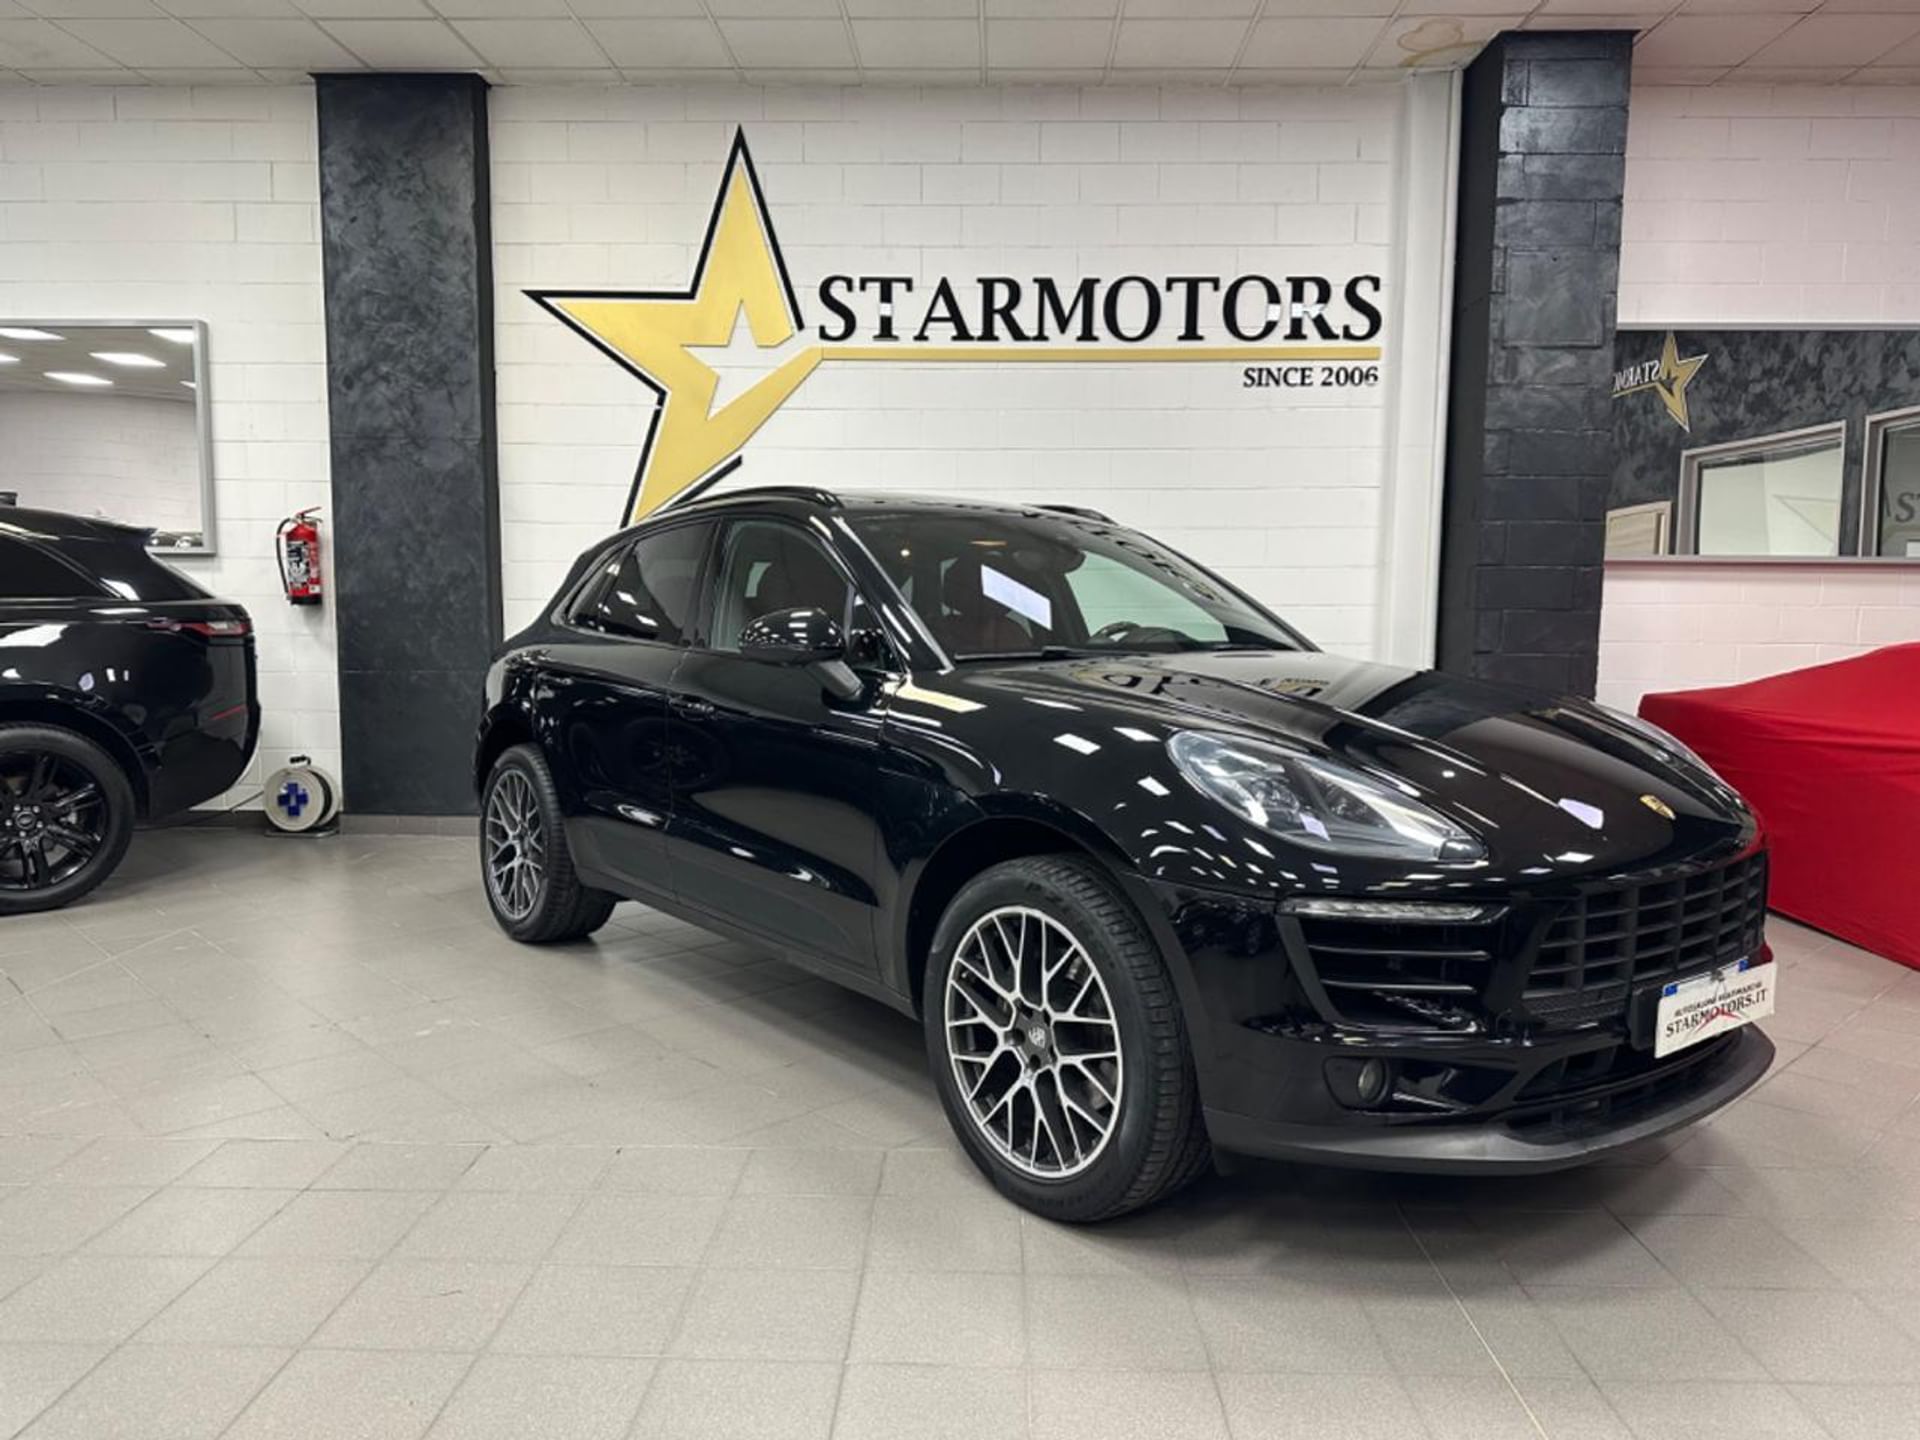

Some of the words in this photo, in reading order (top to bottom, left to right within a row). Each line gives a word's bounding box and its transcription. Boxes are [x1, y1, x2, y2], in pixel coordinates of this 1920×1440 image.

[819, 275, 1382, 342] STARMOTORS
[1243, 366, 1313, 387] SINCE
[1321, 366, 1378, 387] 2006
[1665, 988, 1768, 1038] STARMOTORS.IT
